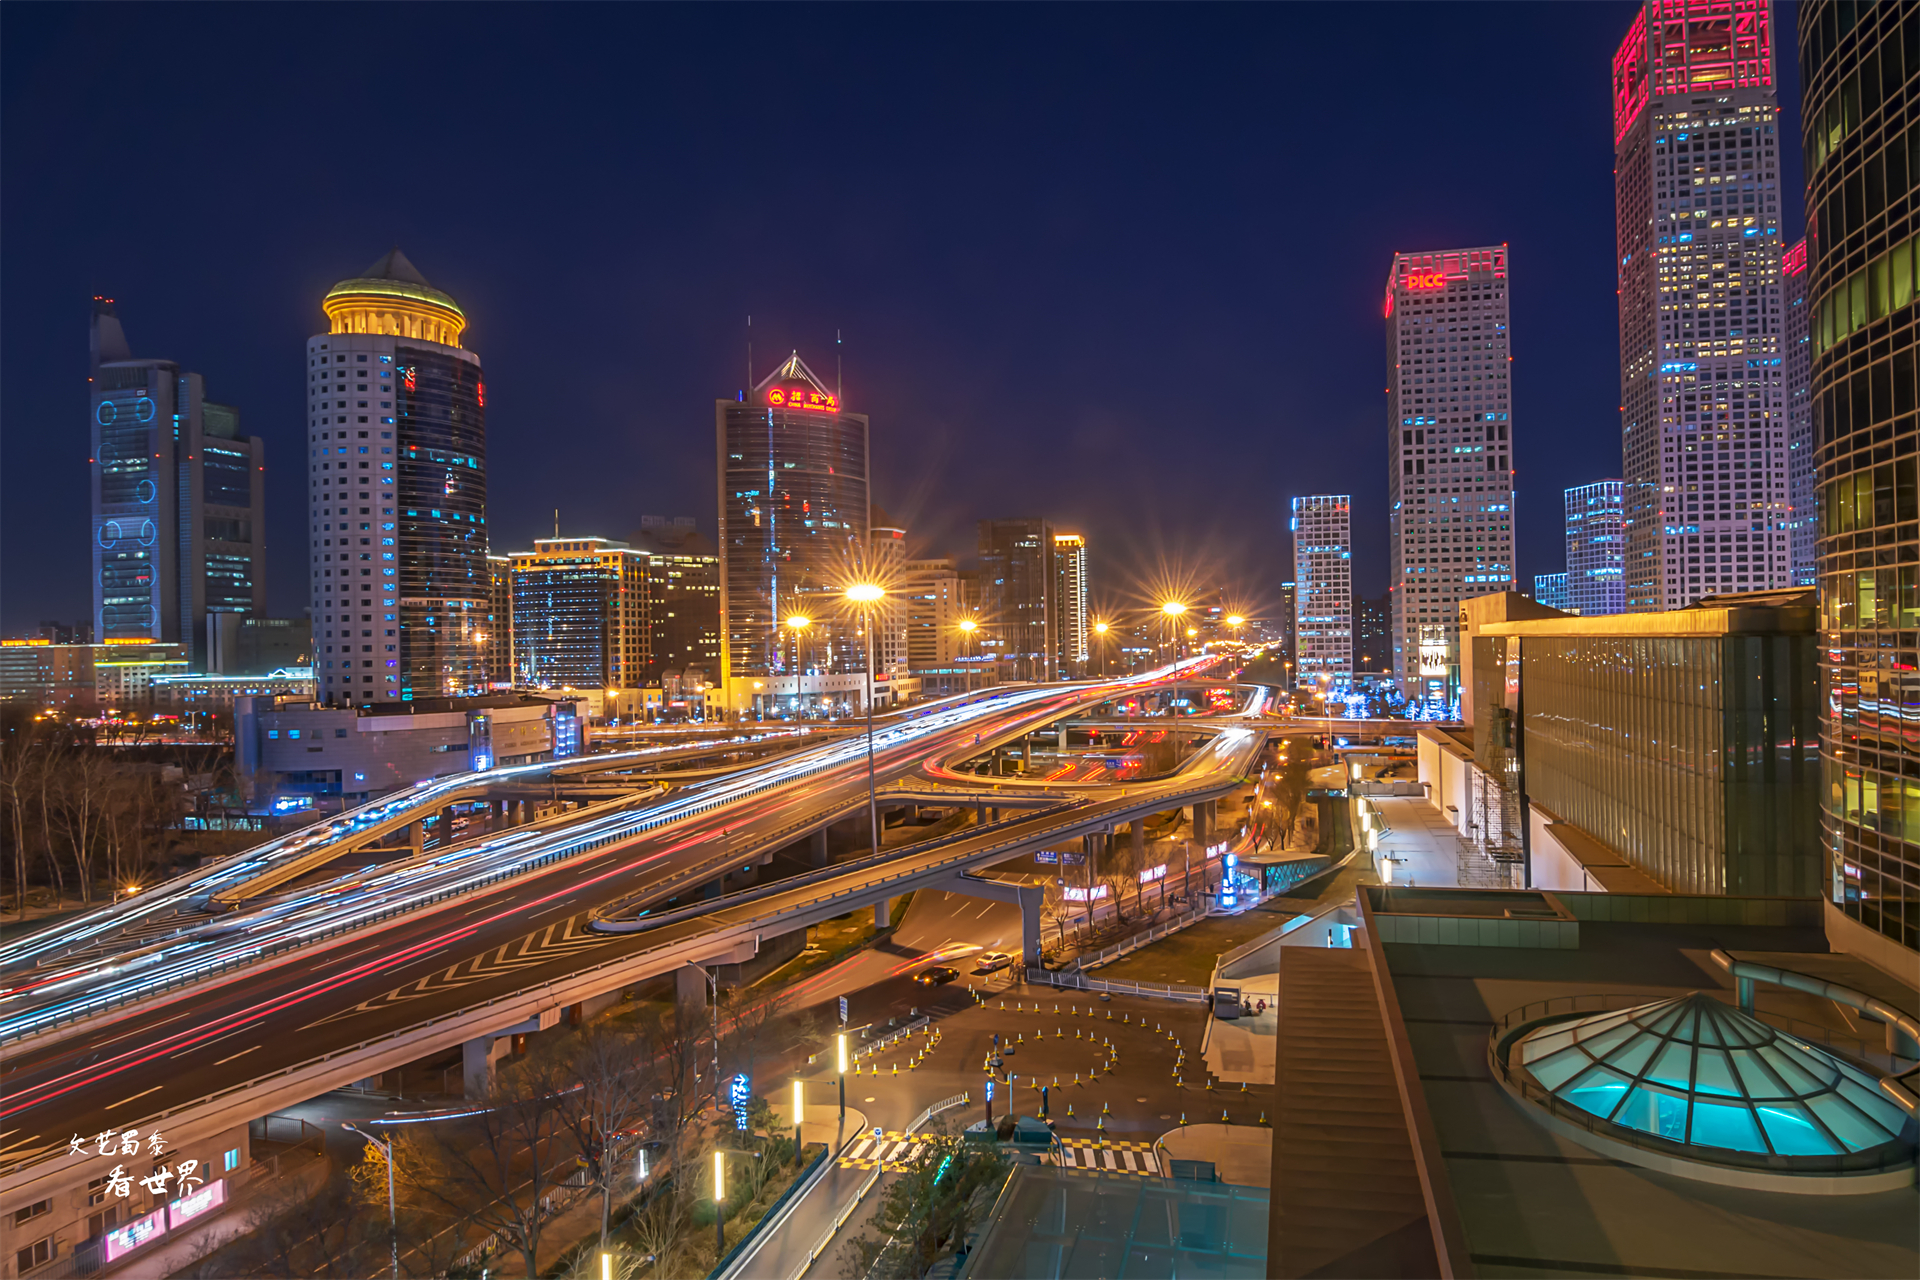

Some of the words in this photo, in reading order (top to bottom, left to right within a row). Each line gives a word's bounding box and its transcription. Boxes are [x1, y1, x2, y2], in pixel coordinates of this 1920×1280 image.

[1408, 274, 1443, 289] PICC
[791, 391, 836, 407] 招商局
